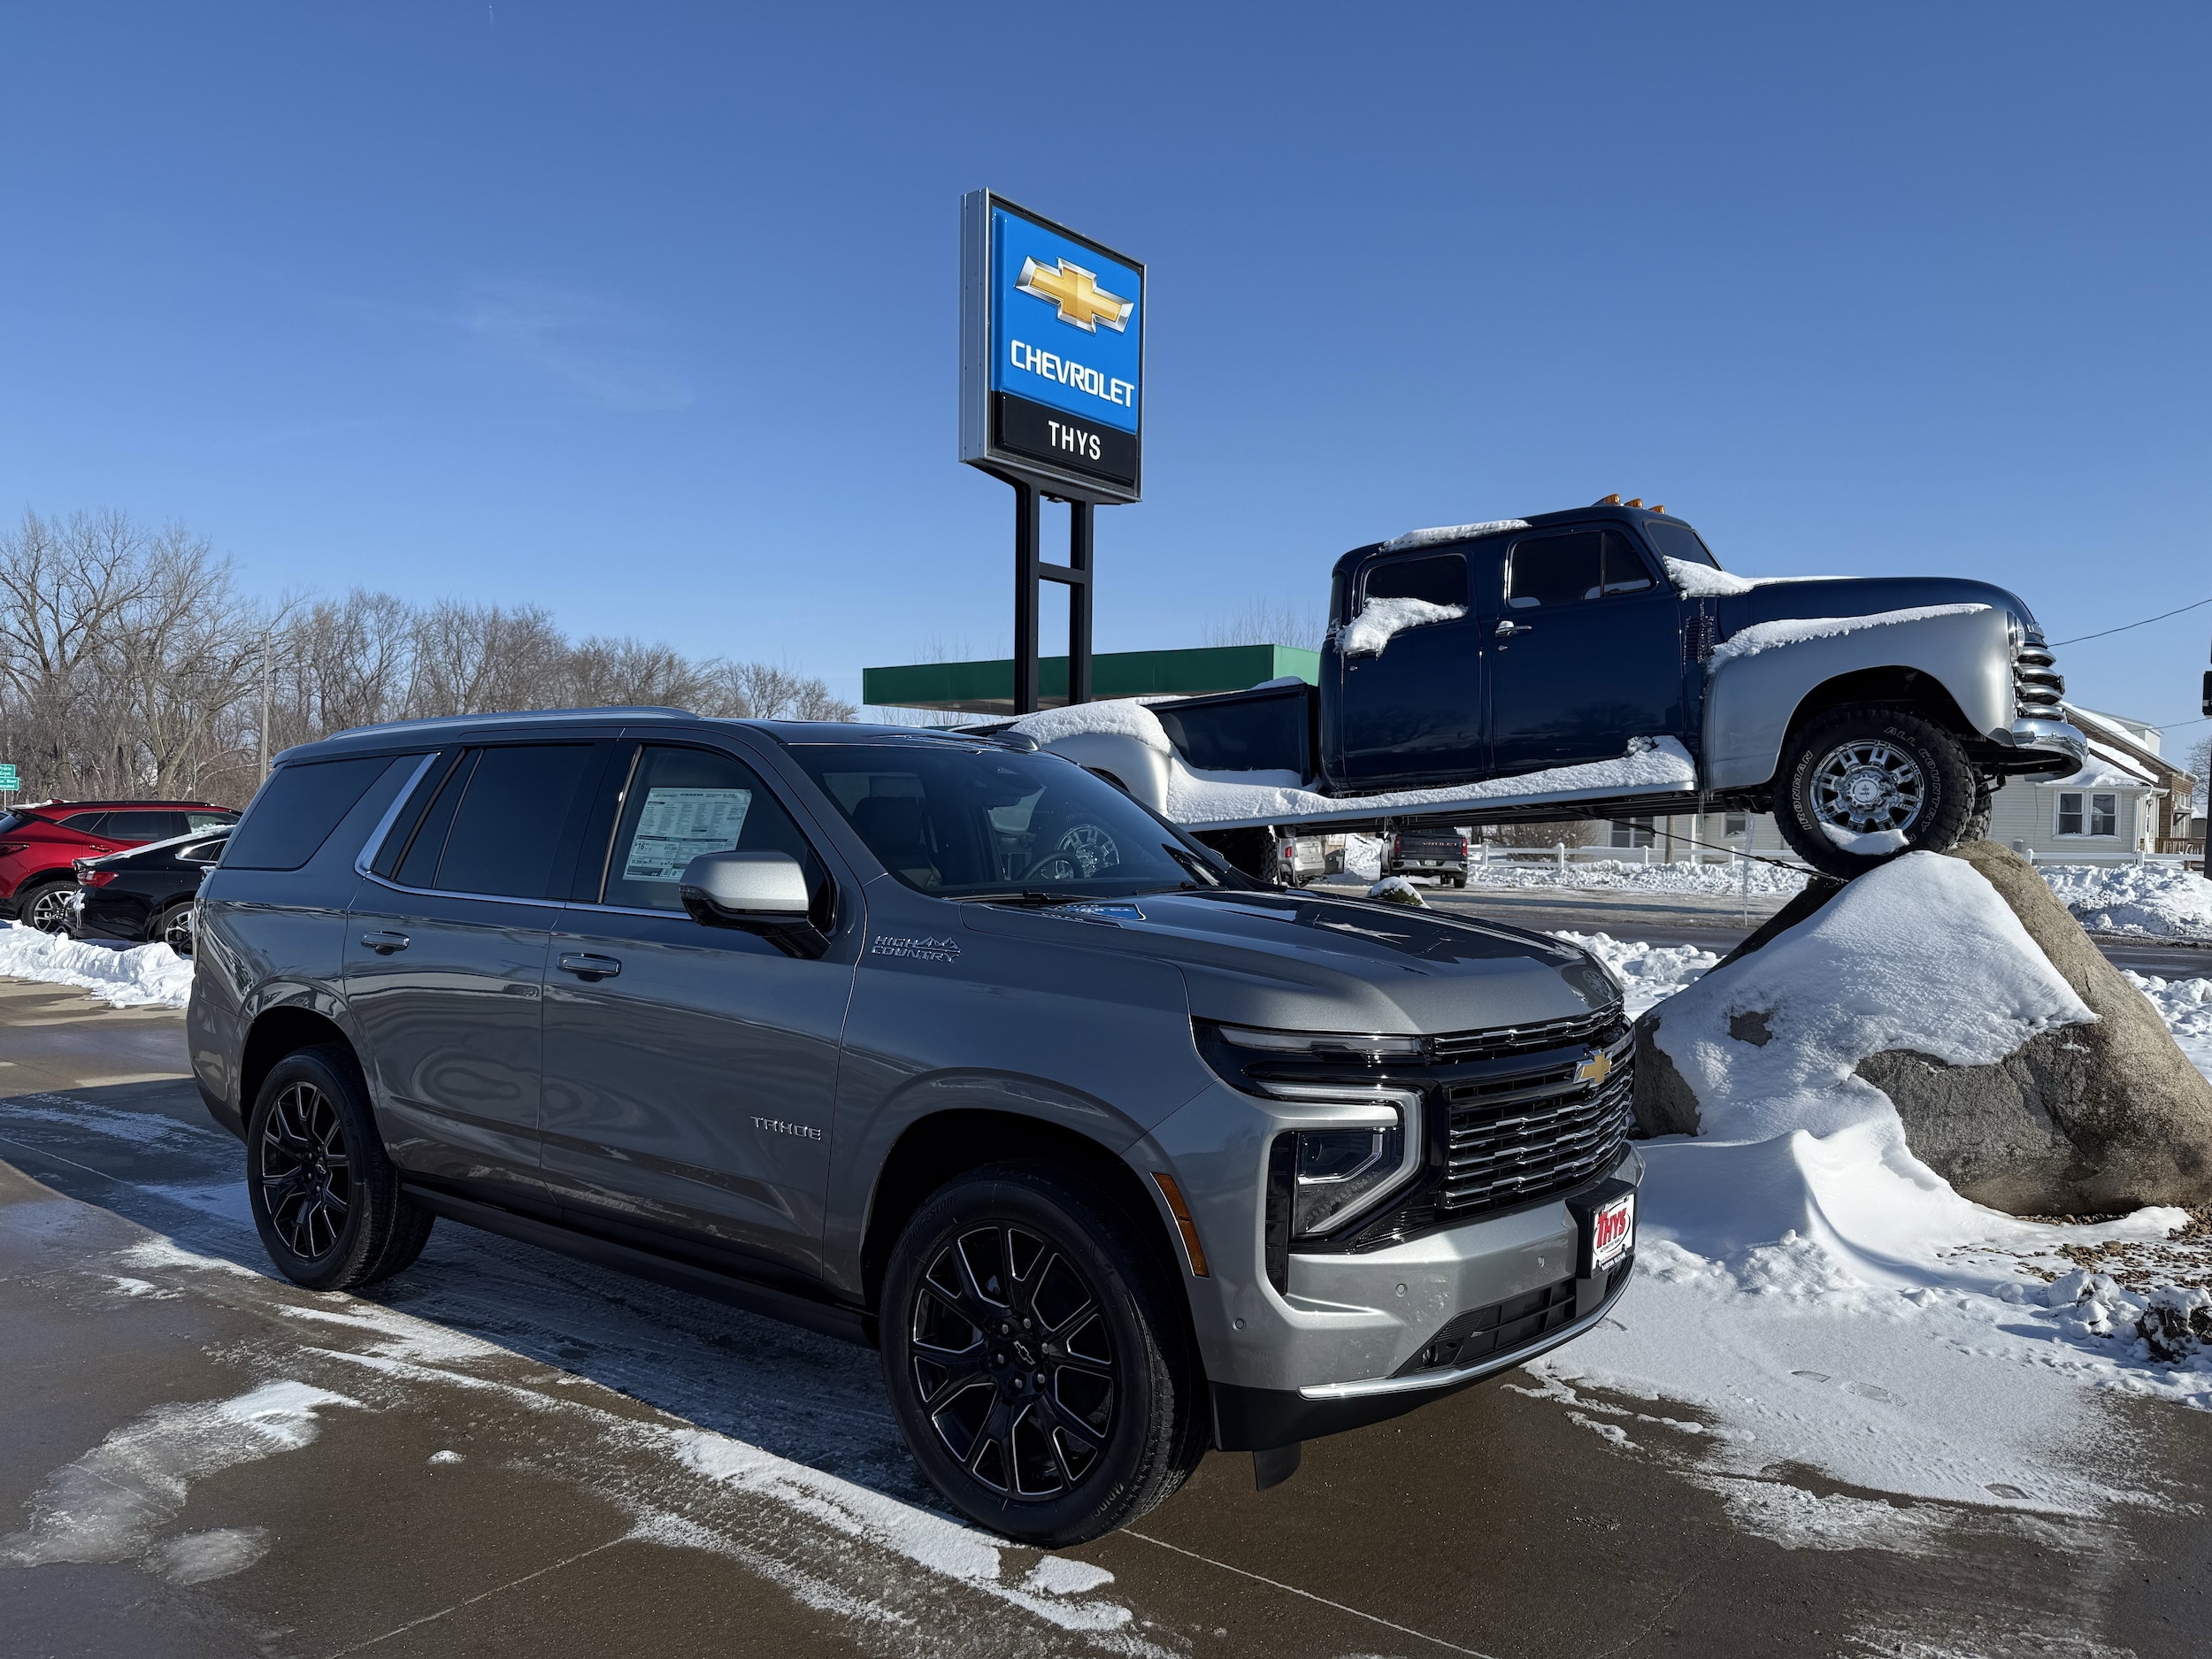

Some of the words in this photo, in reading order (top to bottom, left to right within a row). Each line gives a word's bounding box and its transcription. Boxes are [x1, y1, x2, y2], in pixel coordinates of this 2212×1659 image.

[1011, 340, 1134, 407] CHEVROLET
[1048, 420, 1102, 460] THYS
[1792, 750, 1814, 831] IRONMAN
[1884, 726, 1916, 748] ALL
[1918, 749, 1941, 833] COUNTRY
[872, 946, 959, 963] COUNTRY
[874, 936, 919, 948] HIGH
[750, 1116, 822, 1141] TAHOE
[1596, 1207, 1627, 1249] THYS
